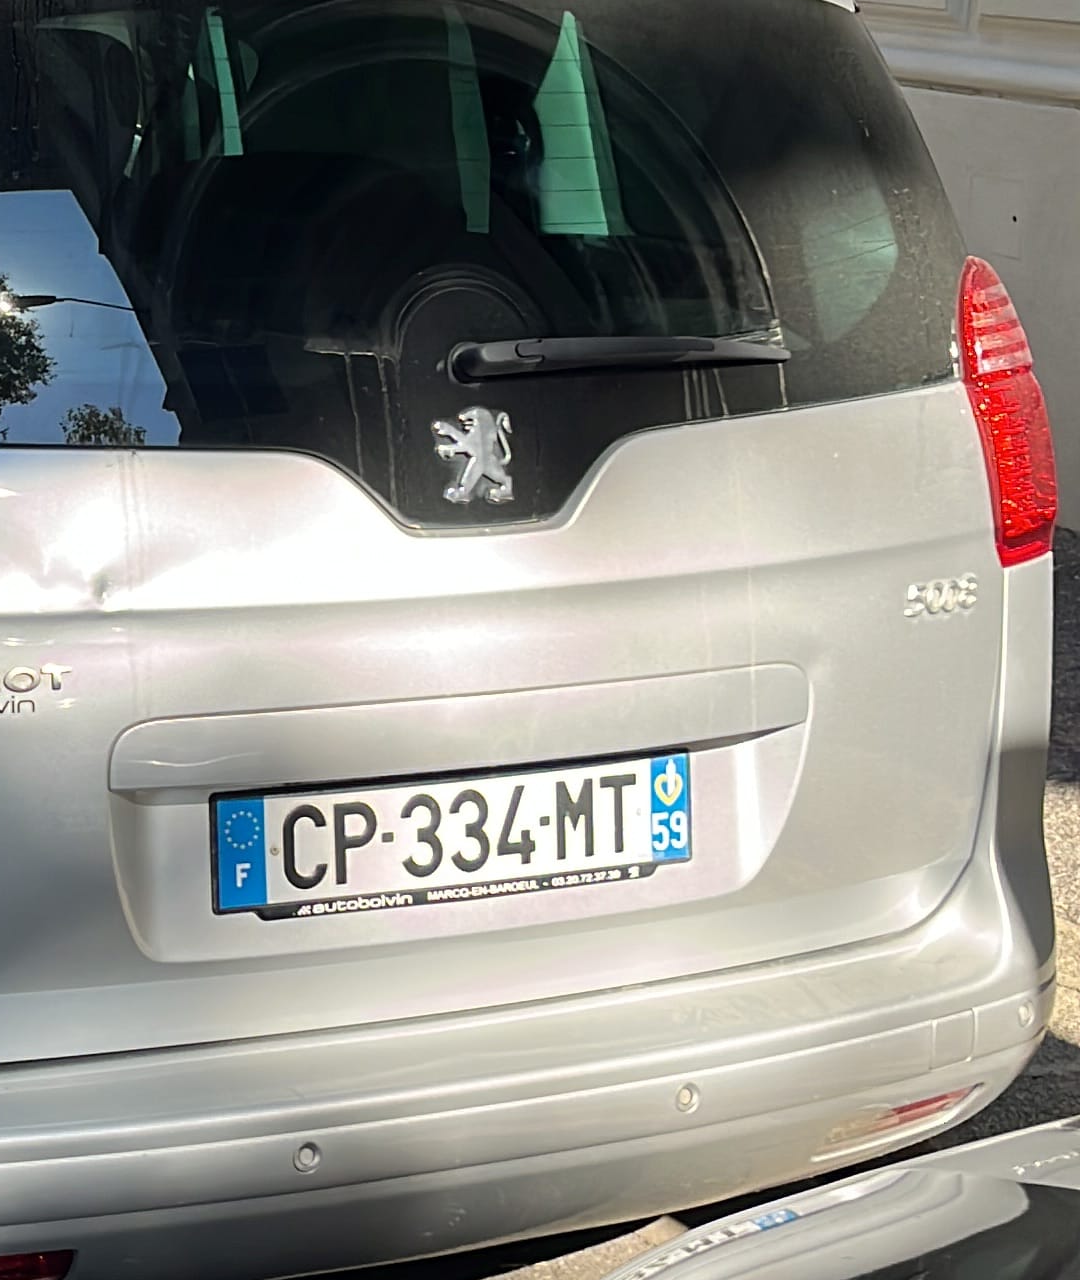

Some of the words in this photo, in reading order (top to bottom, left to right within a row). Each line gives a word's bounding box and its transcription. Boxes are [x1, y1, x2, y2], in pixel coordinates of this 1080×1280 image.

[281, 773, 637, 890] CP-334-MT
[651, 810, 688, 851] 59
[235, 862, 251, 888] F
[311, 892, 414, 915] autobolvin
